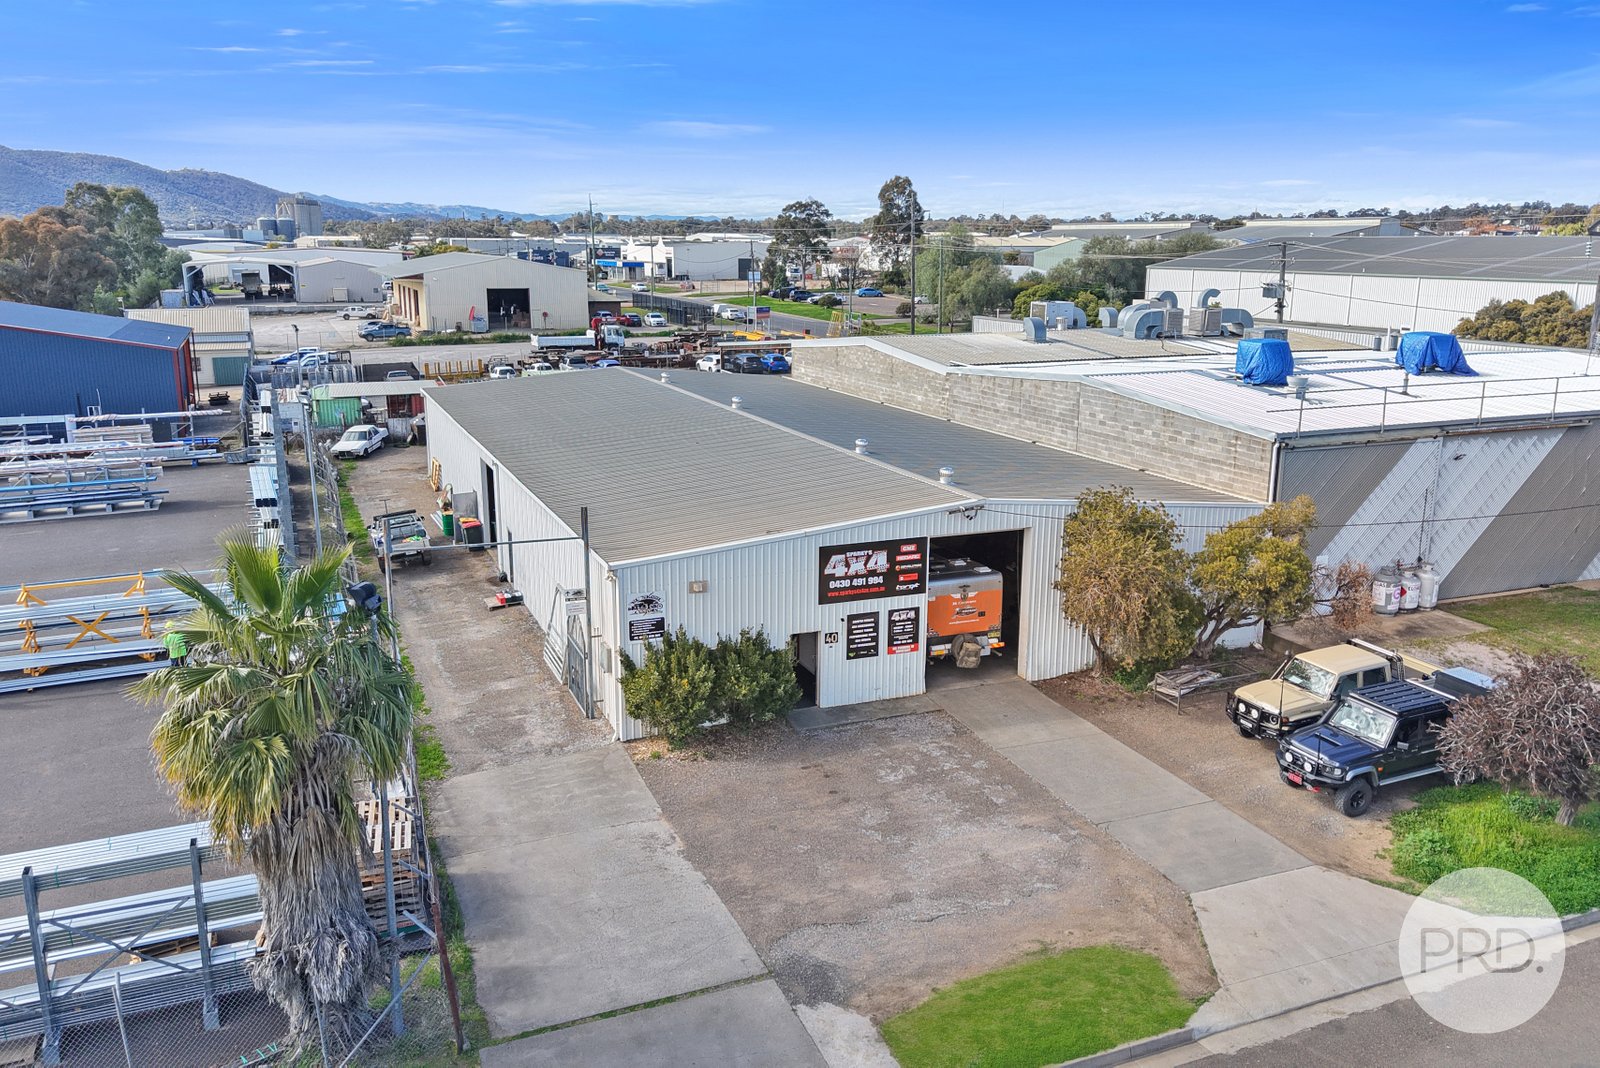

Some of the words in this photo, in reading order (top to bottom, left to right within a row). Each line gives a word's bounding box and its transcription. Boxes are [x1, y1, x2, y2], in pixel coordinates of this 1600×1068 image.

[829, 580, 850, 588] 0430
[852, 578, 866, 586] 491
[868, 576, 883, 584] 994
[826, 633, 837, 643] 40
